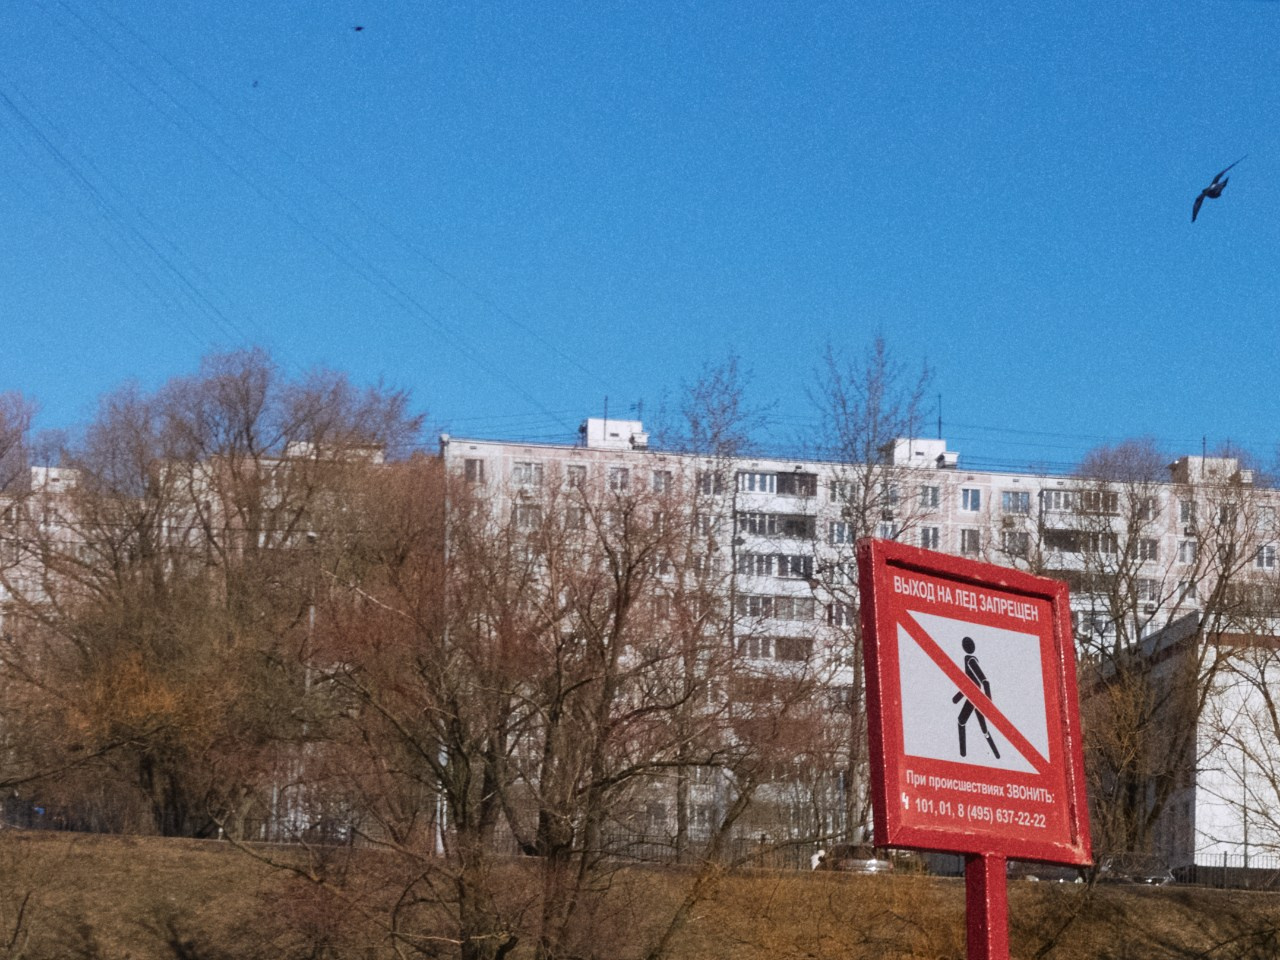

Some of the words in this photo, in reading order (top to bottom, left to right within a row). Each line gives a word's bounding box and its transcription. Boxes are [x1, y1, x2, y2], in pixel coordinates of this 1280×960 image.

[893, 575, 936, 604] ВЫХОД
[937, 585, 953, 605] НА
[955, 589, 978, 612] ЛЕД
[979, 594, 1039, 622] ЗАПРЕЩЕН
[906, 769, 927, 788] При
[928, 775, 1004, 797] происшествиях
[1006, 783, 1055, 804] ЗВОНИТЬ:
[915, 797, 938, 817] 101,
[939, 801, 955, 819] 01,
[957, 803, 965, 817] 8
[967, 804, 994, 824] (495)
[996, 808, 1046, 828] 637-22-22
